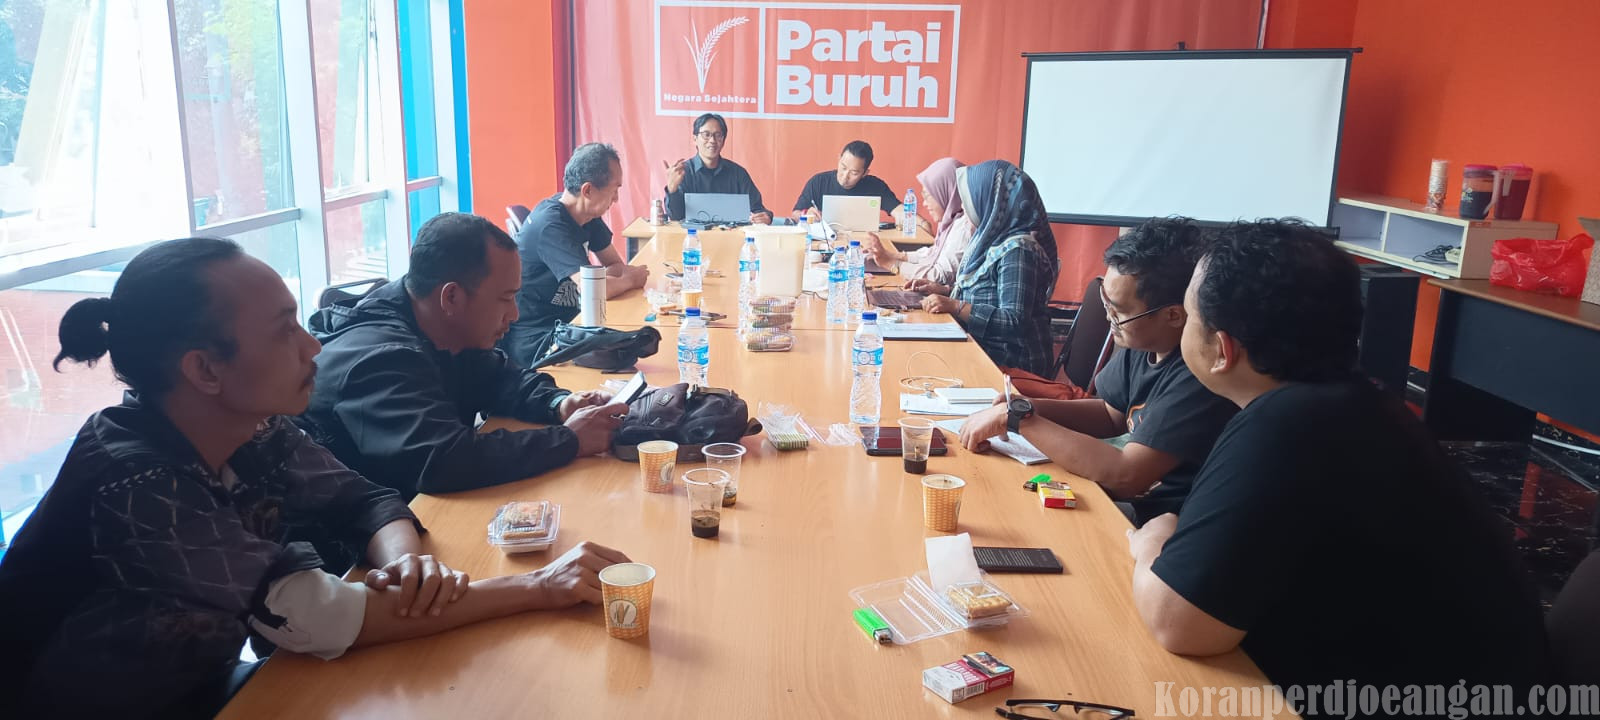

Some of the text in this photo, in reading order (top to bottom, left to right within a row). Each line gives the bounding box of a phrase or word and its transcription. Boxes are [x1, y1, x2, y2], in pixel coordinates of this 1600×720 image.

[777, 19, 942, 63] Partai
[663, 93, 757, 104] Negara Sejahtera
[776, 65, 939, 109] Buruh
